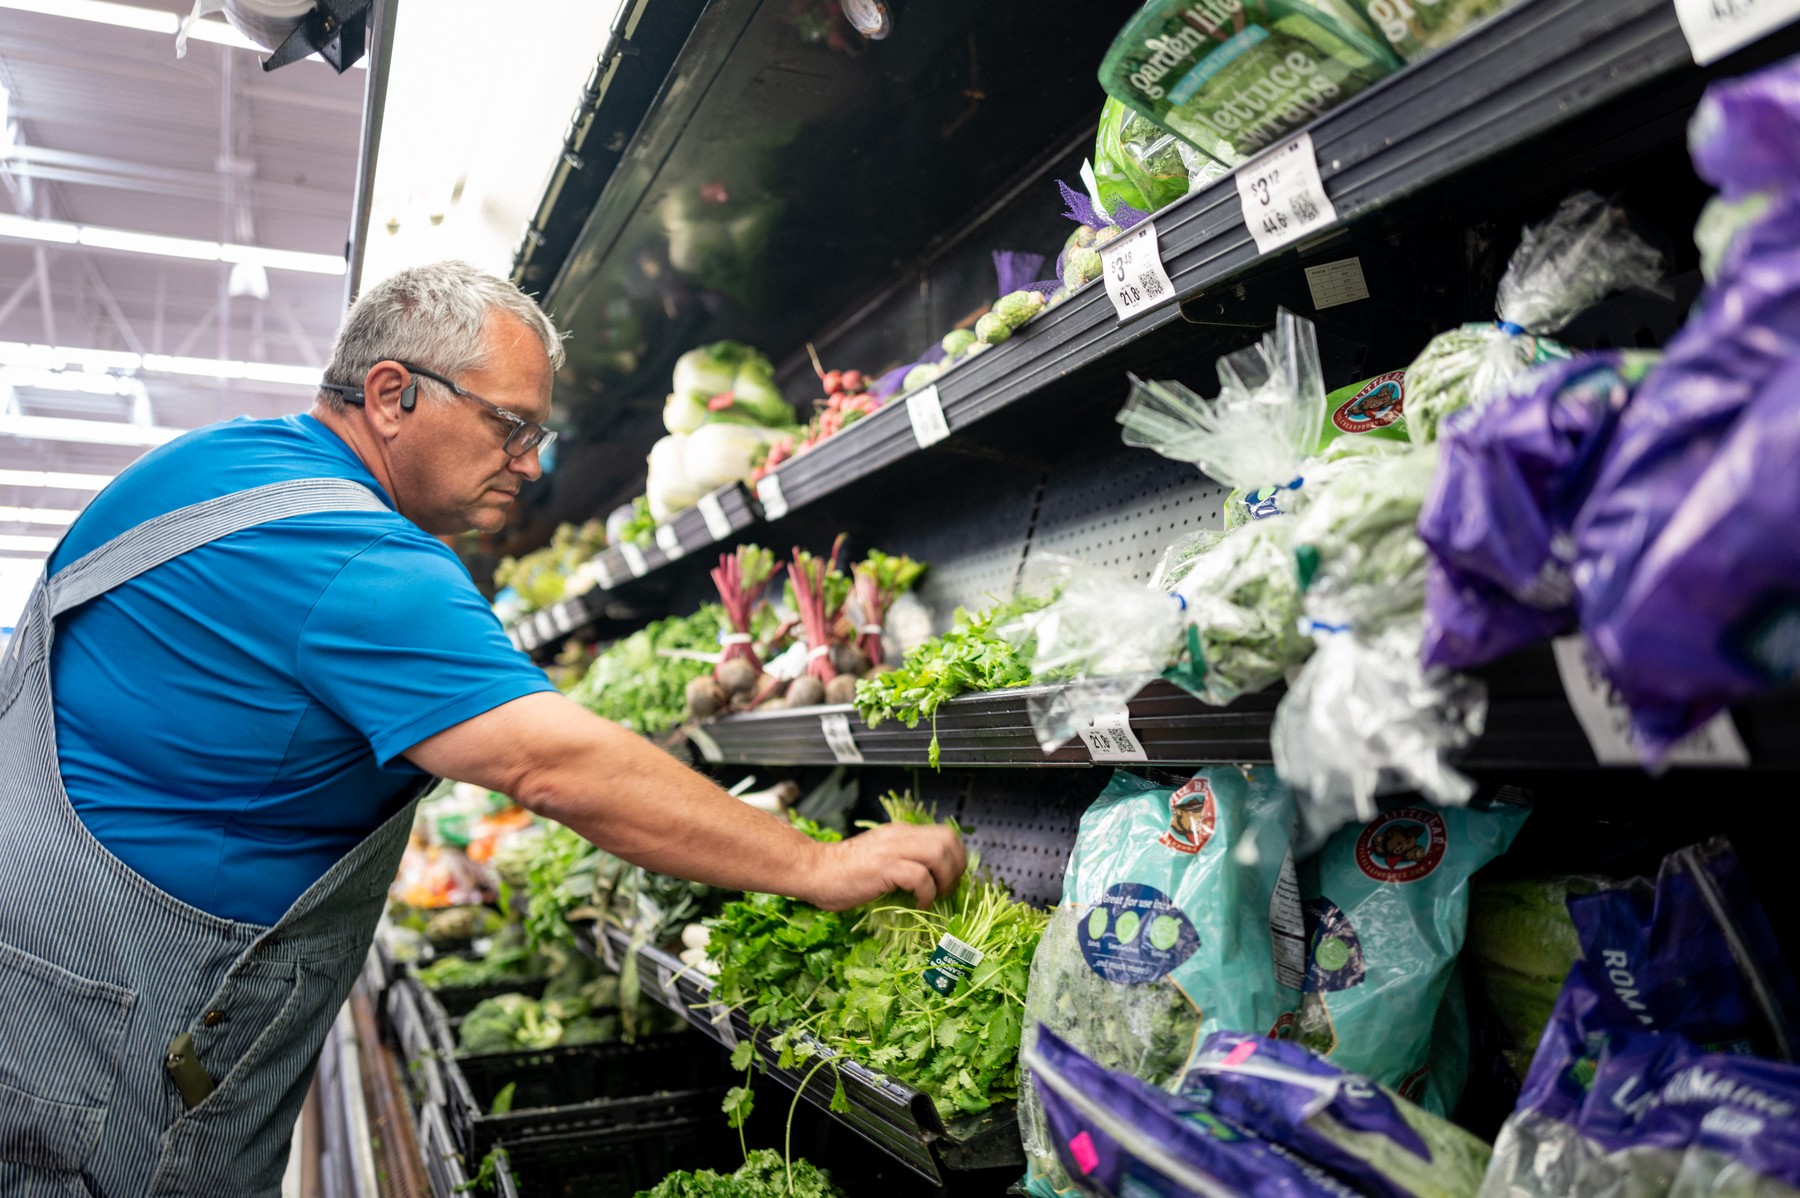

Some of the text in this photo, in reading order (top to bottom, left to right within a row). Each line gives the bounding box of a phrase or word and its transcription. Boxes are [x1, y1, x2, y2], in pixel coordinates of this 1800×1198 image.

[1130, 26, 1206, 100] garden
[1194, 50, 1318, 137] lettuce
[1235, 74, 1341, 150] wraps
[1354, 373, 1392, 400] LITTLE
[1102, 893, 1125, 905] Great
[1121, 895, 1139, 909] for
